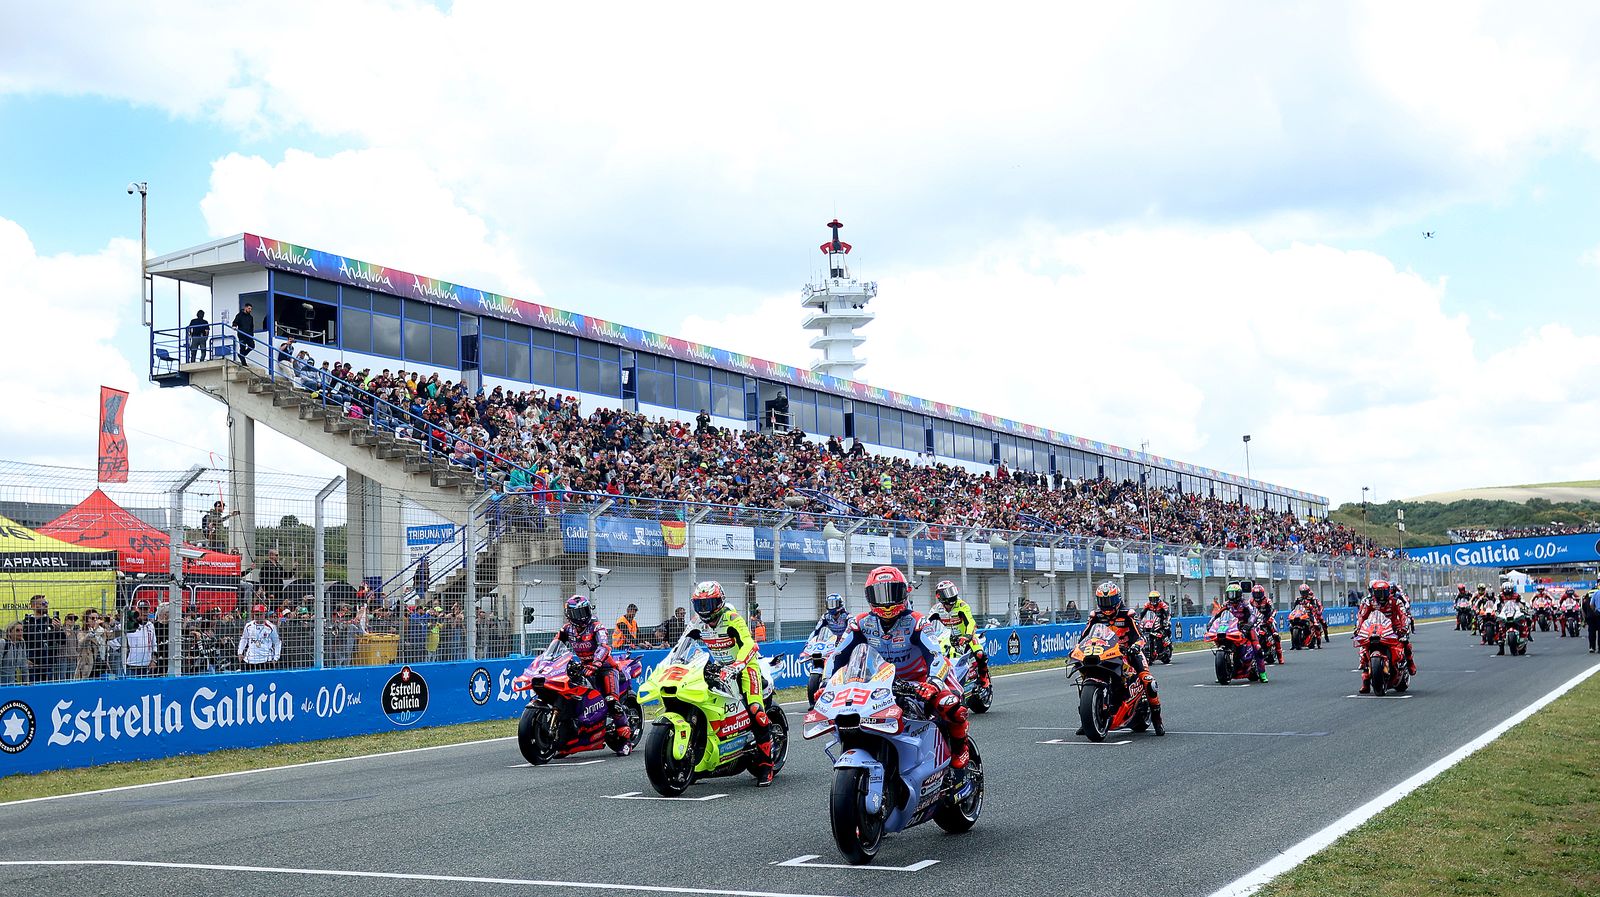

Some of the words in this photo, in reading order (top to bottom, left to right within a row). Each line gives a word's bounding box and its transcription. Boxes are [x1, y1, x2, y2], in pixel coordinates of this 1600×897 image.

[256, 236, 318, 271] Andalucía
[339, 256, 394, 288] Andalucía
[412, 275, 461, 304] Andalucía
[478, 292, 522, 318] Andalucía
[538, 306, 580, 331] Andalucía
[592, 318, 629, 342] Andalucía
[641, 331, 674, 352] Andalucía
[687, 342, 716, 363] Andalucía
[408, 529, 440, 540] TRIBUNA
[441, 528, 454, 539] VIP
[3, 557, 68, 567] APPAREL
[1455, 544, 1520, 566] Galicia
[1535, 542, 1556, 559] 0,0
[1040, 634, 1064, 653] Estrella
[658, 666, 689, 683] 72
[390, 682, 421, 696] Estrella
[831, 688, 872, 708] 93
[391, 696, 420, 710] Galicia
[584, 700, 605, 718] prima
[48, 694, 183, 746] Estrella
[190, 683, 295, 730] Galicia
[317, 683, 346, 717] 0,0
